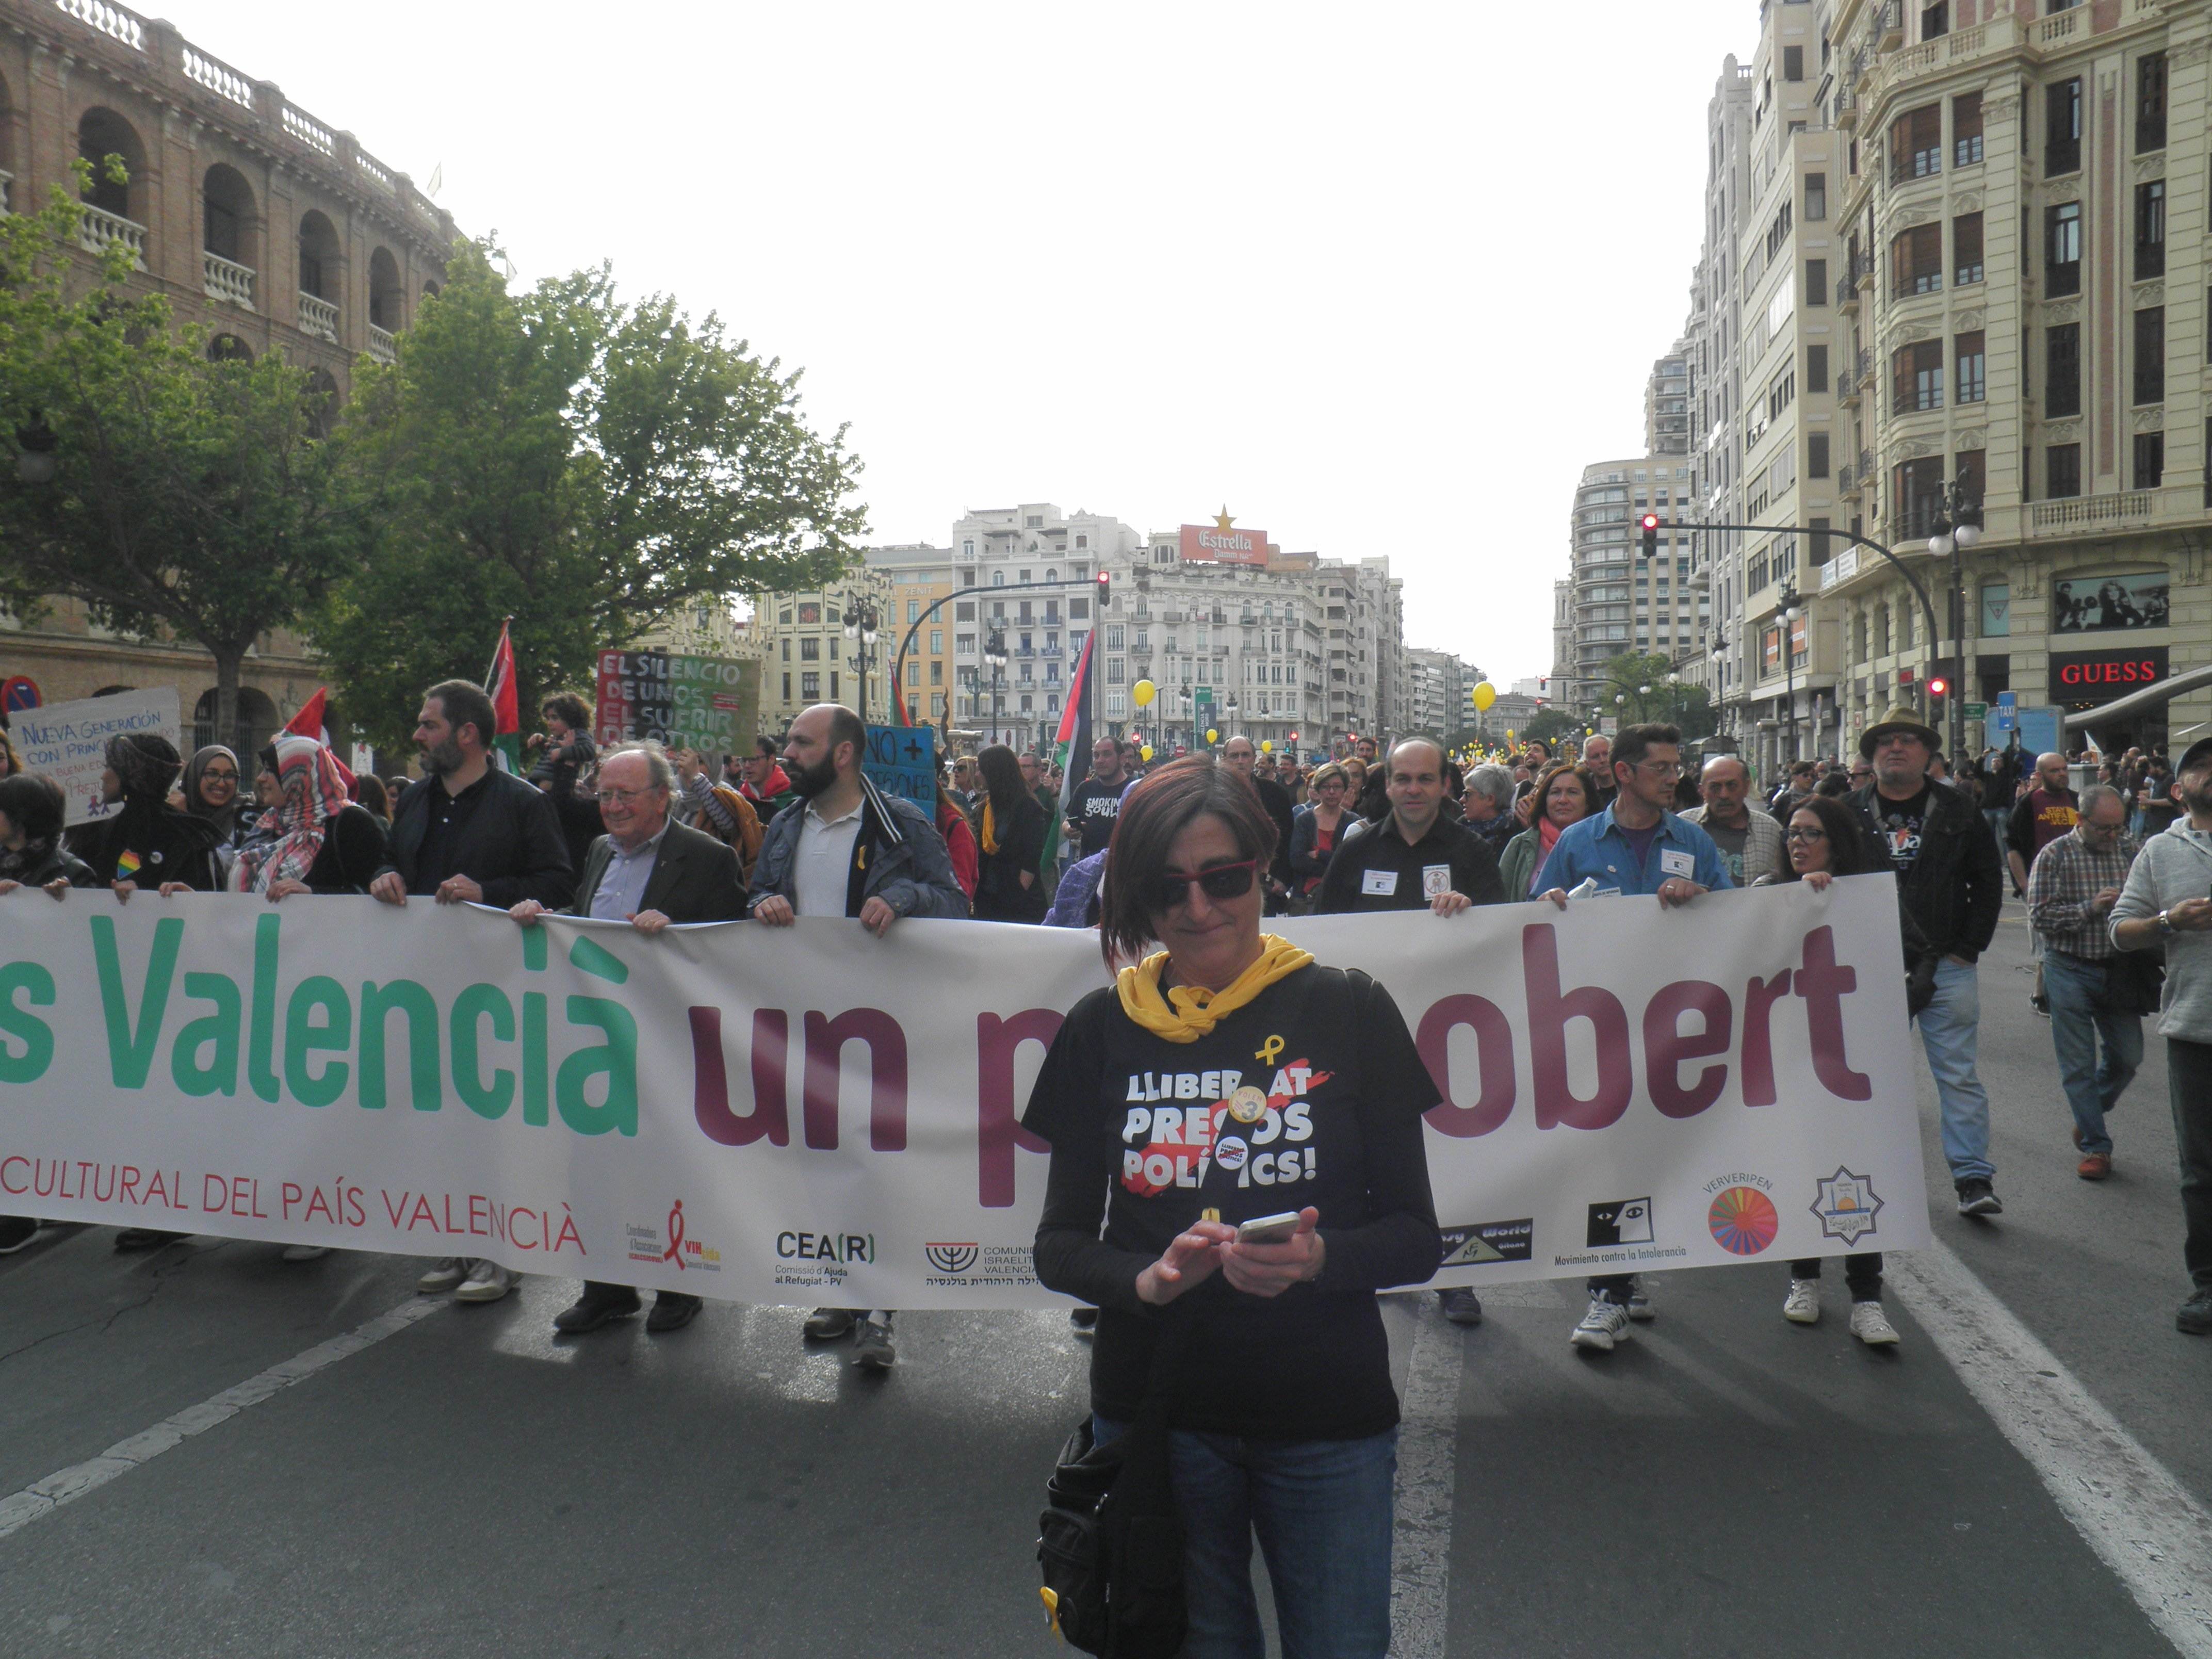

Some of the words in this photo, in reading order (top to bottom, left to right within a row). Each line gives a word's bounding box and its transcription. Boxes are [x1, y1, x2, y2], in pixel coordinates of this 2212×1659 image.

[1199, 530, 1252, 550] Estrella
[1214, 549, 1237, 559] Damm
[905, 586, 933, 596] ZENIT
[603, 654, 631, 676] EL
[636, 655, 741, 685] SILENCIO
[2061, 661, 2155, 684] GUESS
[607, 680, 636, 701] DE
[640, 682, 706, 708] UNOS
[603, 702, 636, 724] EL
[641, 706, 735, 736] SUFRIR
[1999, 706, 2014, 717] TAXI
[22, 723, 77, 745] NUEVA
[80, 709, 161, 739] GENERACIÓN
[602, 724, 636, 742] DE
[646, 728, 732, 754] OTROS
[27, 749, 59, 765] CON
[0, 961, 56, 1084] s
[90, 913, 638, 1137] Valencià
[689, 1006, 907, 1152] un
[1416, 922, 1873, 1138] obert
[1702, 1173, 1773, 1194] VERVERIPEN
[1, 1156, 188, 1210] CULTURAL
[203, 1174, 268, 1218] DEL
[283, 1177, 366, 1228] PAÍS
[381, 1190, 587, 1256] VALENCIÀ
[1482, 1224, 1531, 1238] World
[776, 1231, 875, 1264] CEA(R)
[1555, 1255, 1599, 1266] Movimiento
[1601, 1251, 1625, 1262] contra
[1628, 1248, 1636, 1260] la
[1638, 1246, 1686, 1259] Intolerancia
[775, 1265, 815, 1275] Comissió
[785, 1276, 822, 1287] Refugiat
